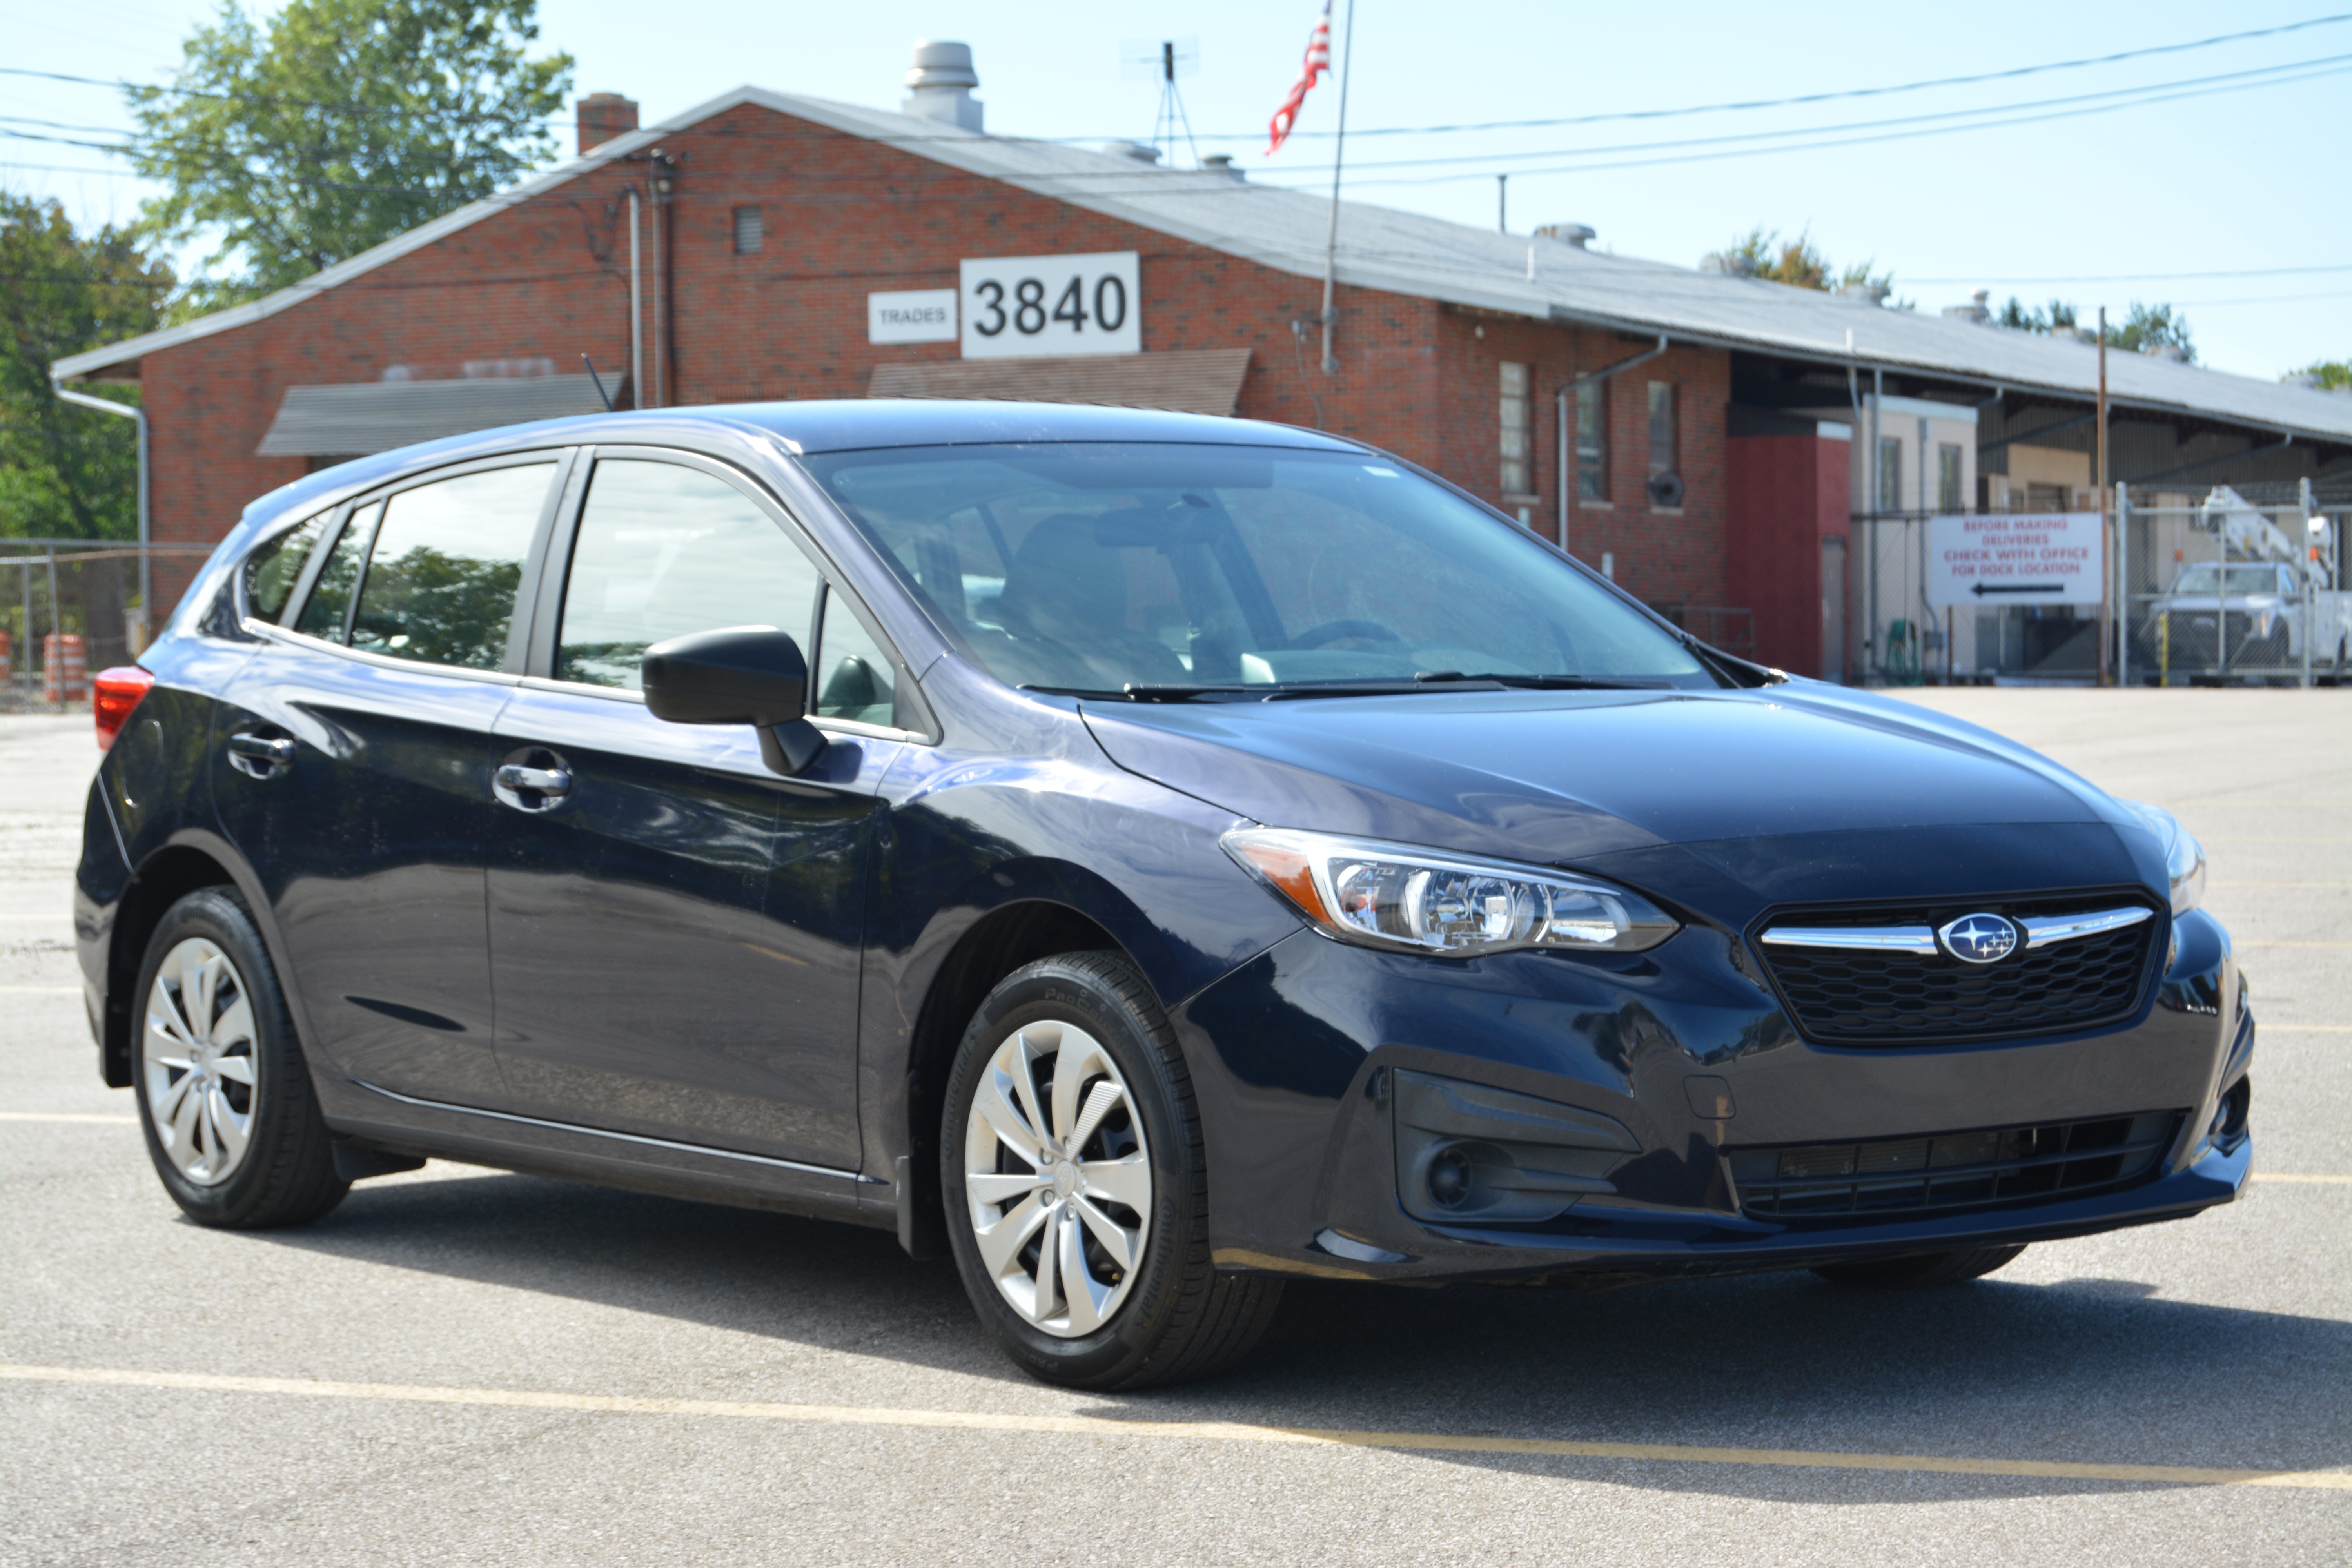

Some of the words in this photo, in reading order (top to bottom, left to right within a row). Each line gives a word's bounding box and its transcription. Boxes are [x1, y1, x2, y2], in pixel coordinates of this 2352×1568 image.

[975, 274, 1126, 336] 3840
[880, 307, 947, 325] TRADES
[1964, 520, 2009, 532] BEFORE
[2014, 518, 2068, 530] MAKING
[1982, 534, 2049, 546] DELIVERIES
[1944, 549, 1990, 562] CHECK
[1996, 548, 2035, 561] WITH
[2040, 547, 2089, 560] OFFICE
[1952, 564, 1975, 576] FOR
[1980, 563, 2013, 575] DOCK
[2018, 562, 2080, 575] LOCATION
